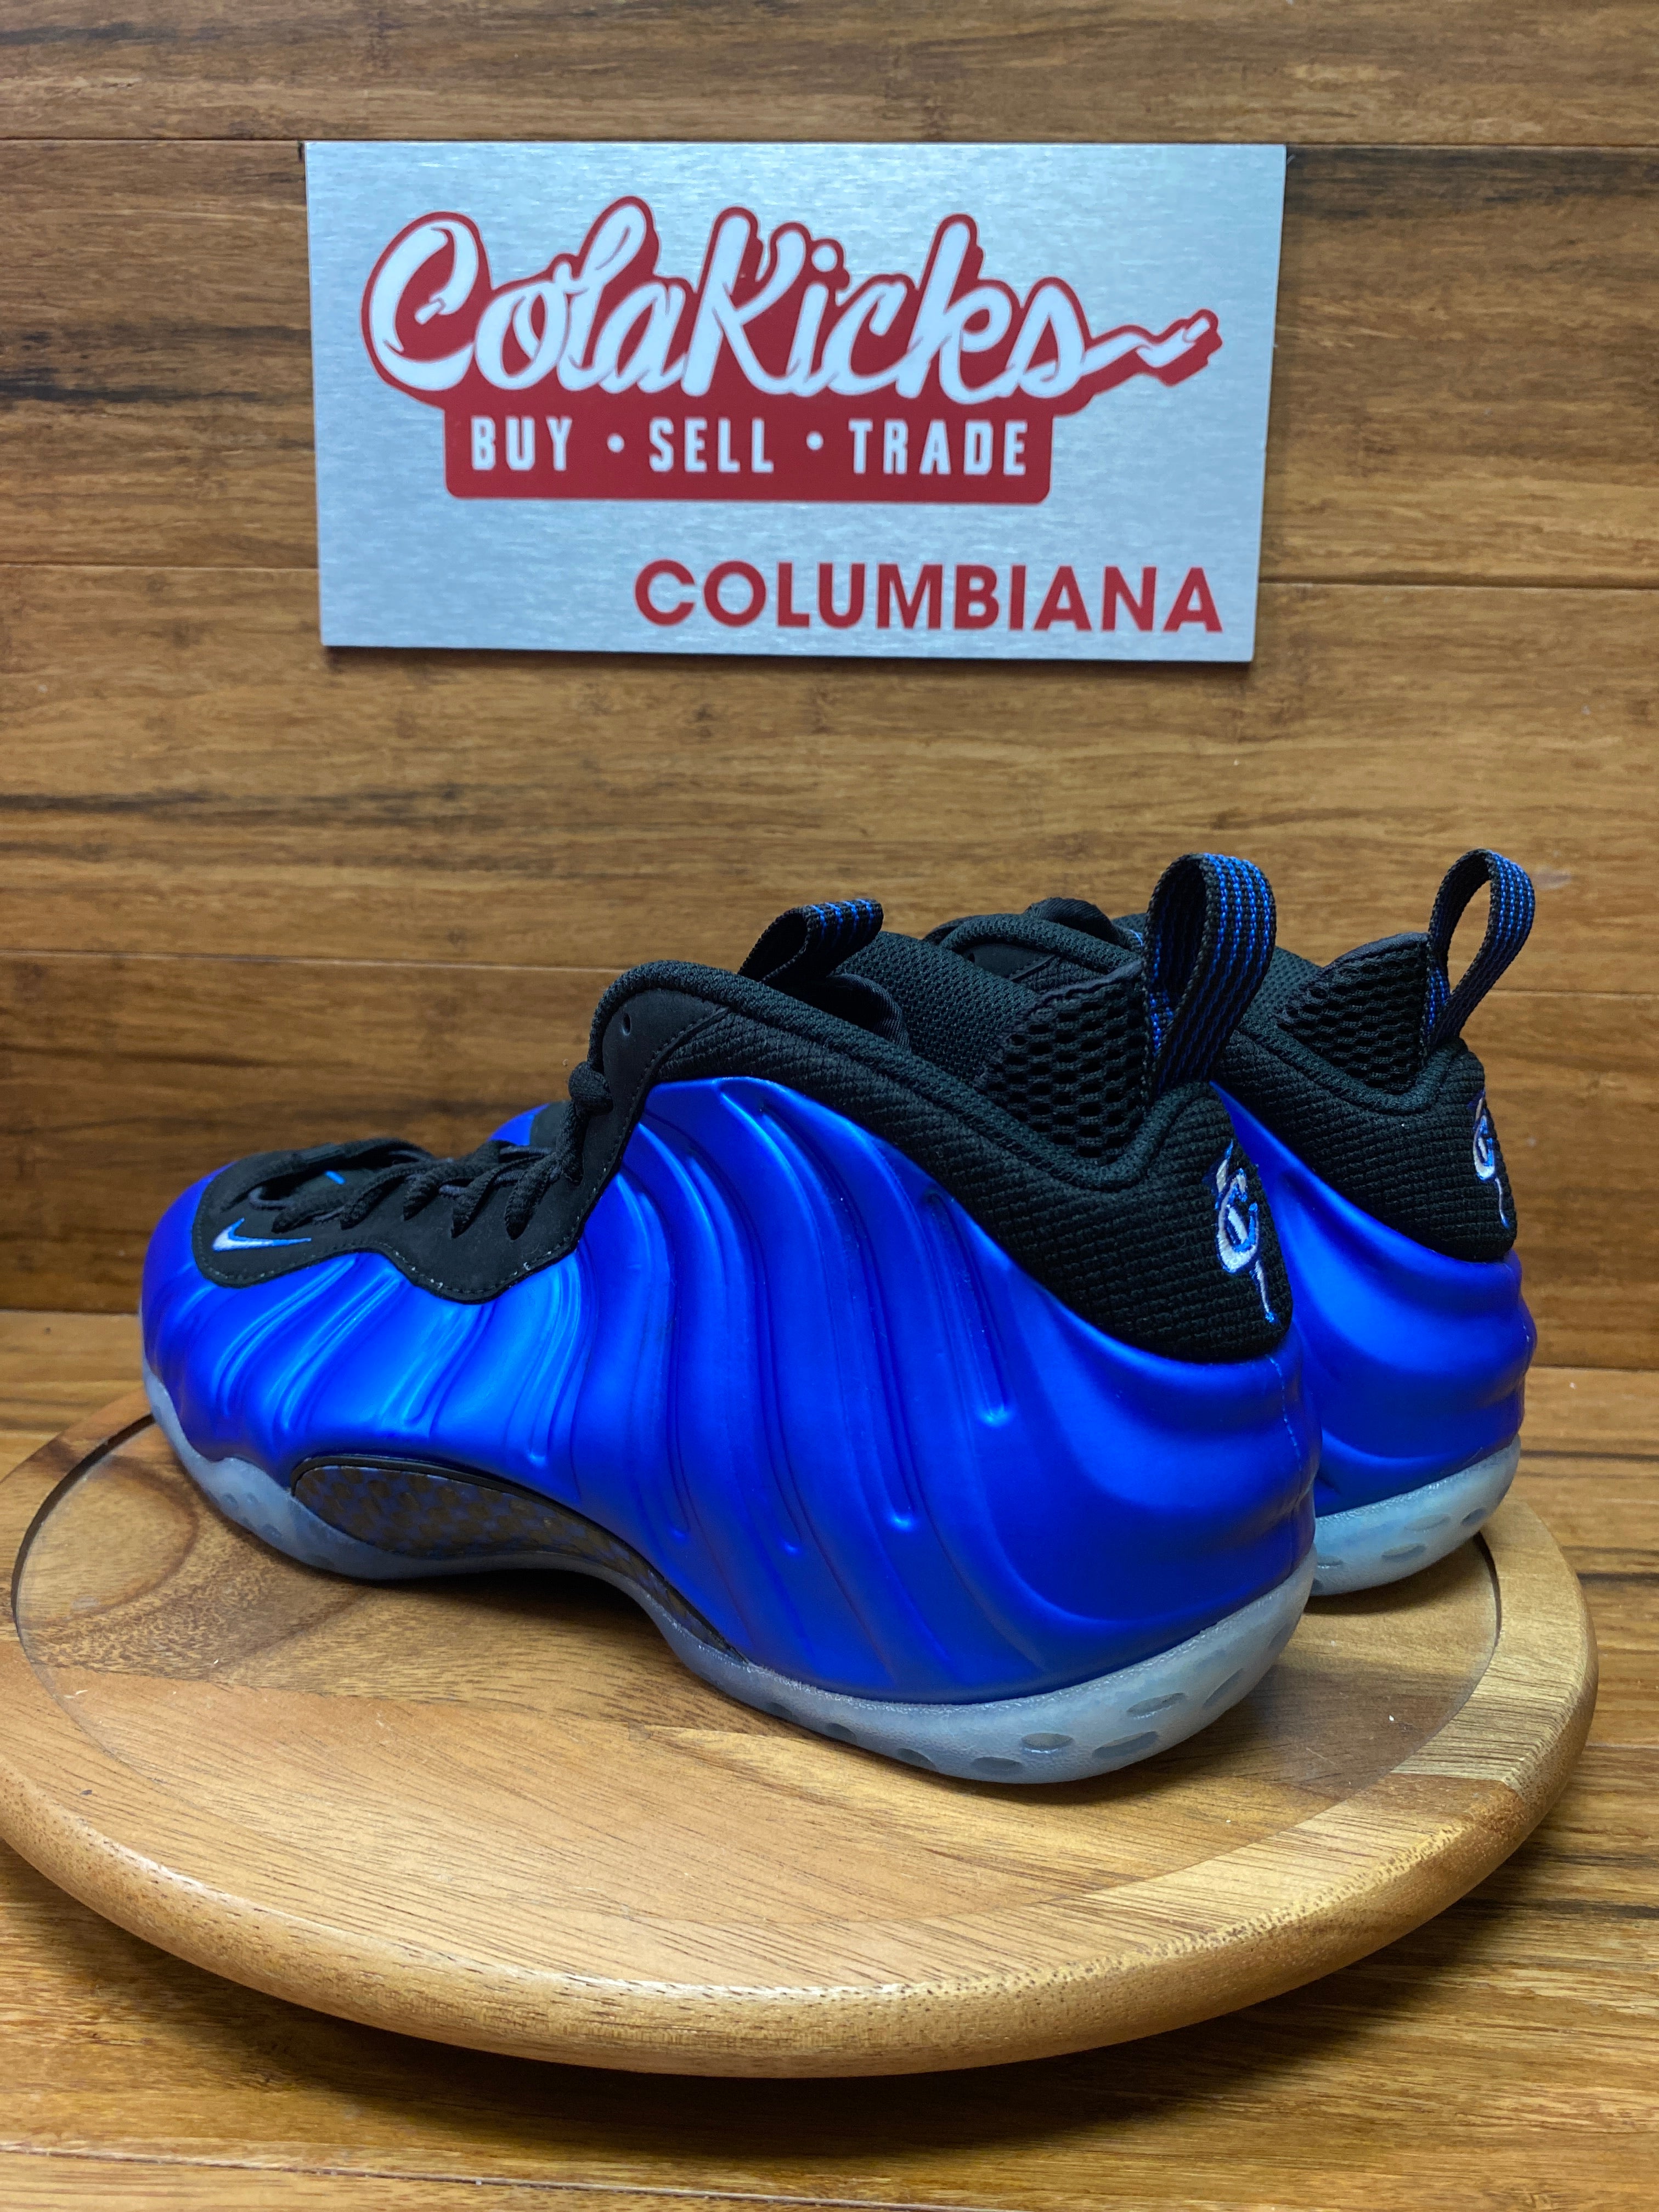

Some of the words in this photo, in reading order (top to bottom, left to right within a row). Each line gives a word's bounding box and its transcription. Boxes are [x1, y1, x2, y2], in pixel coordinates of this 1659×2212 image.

[364, 198, 1214, 406] ColaKicks
[470, 414, 573, 472] BUY
[648, 416, 775, 475] SELL
[848, 417, 1029, 477] TRADE
[635, 560, 1222, 631] COLUMBIANA
